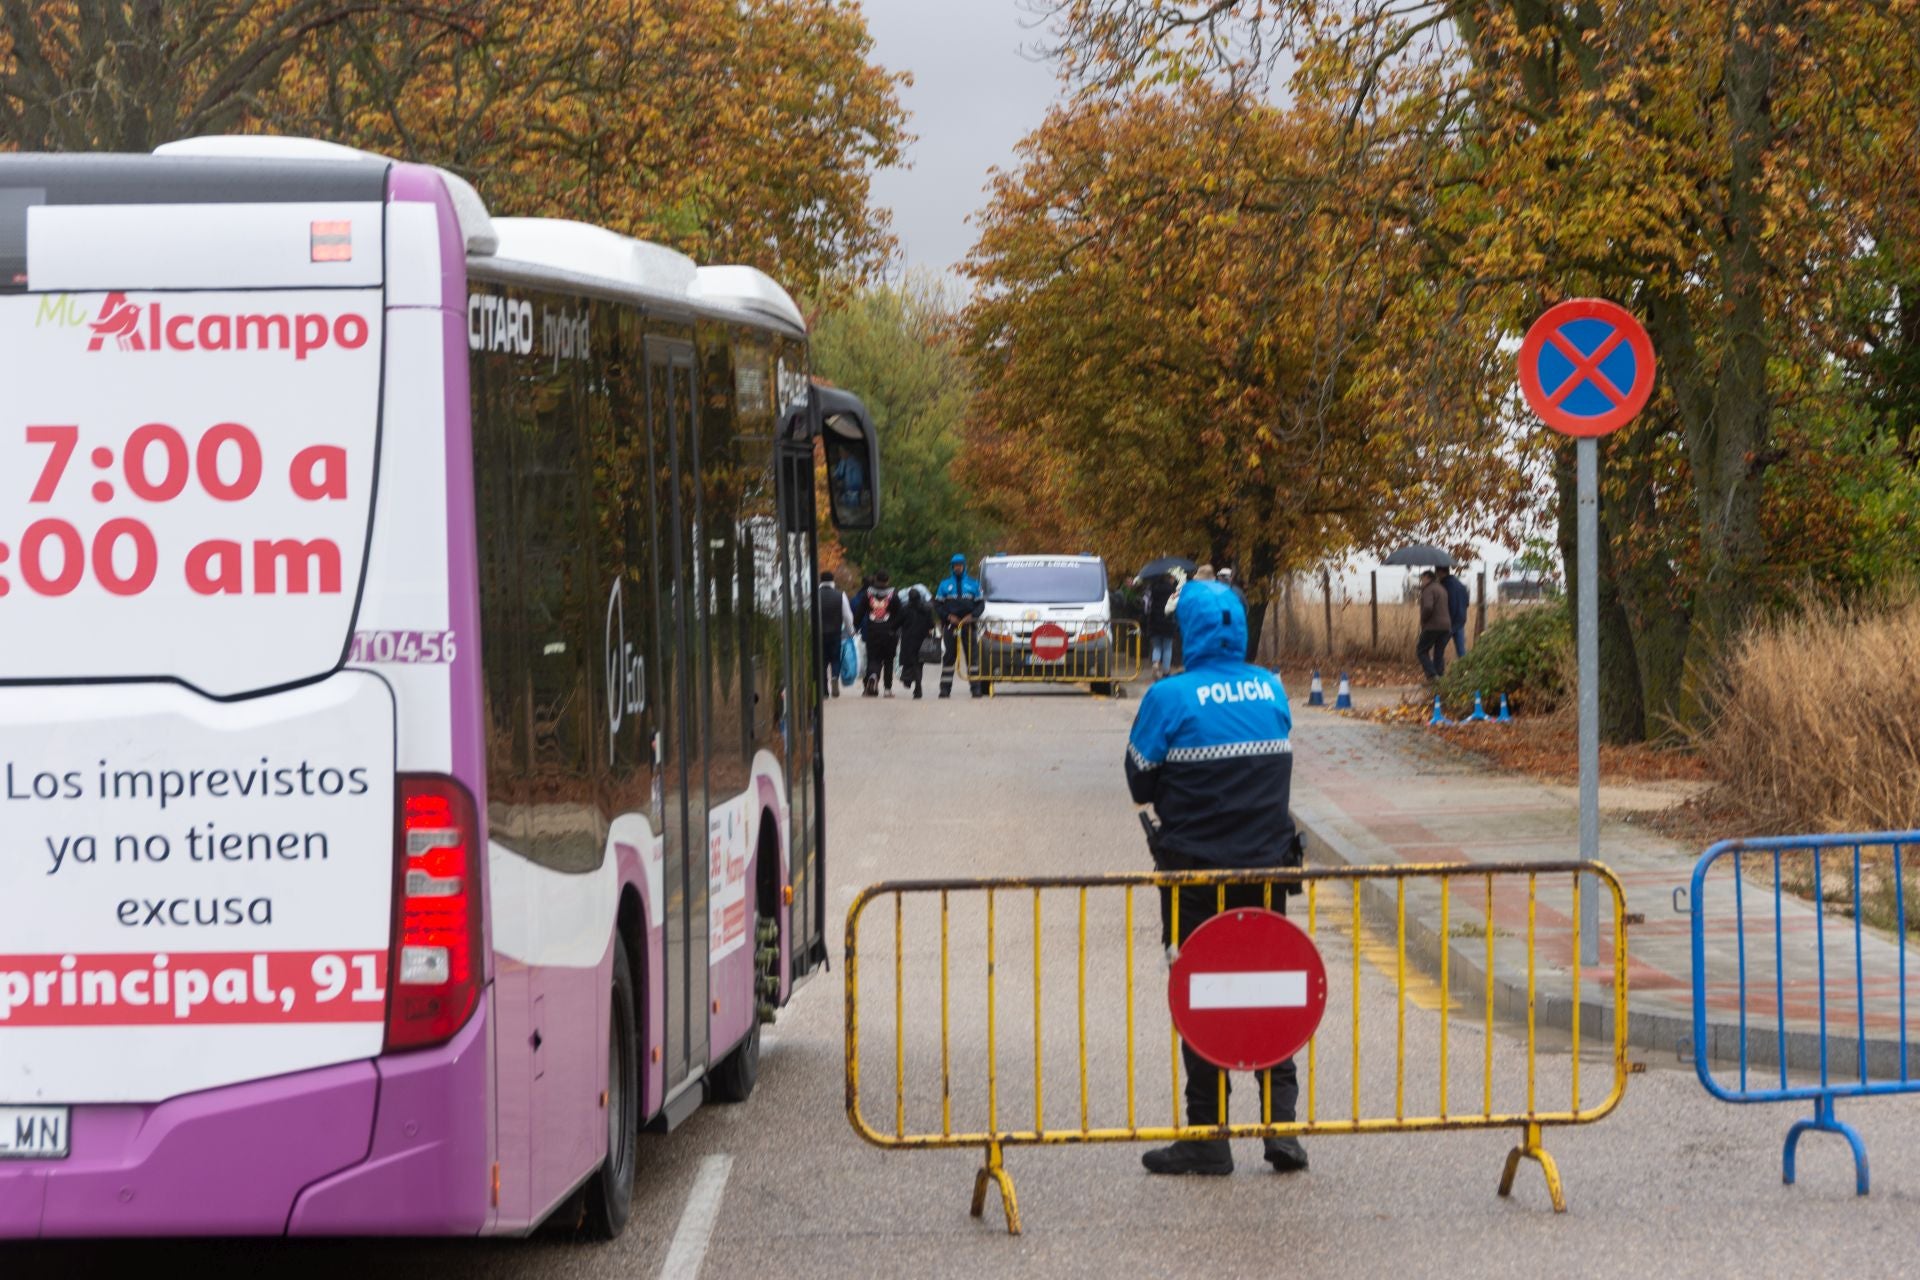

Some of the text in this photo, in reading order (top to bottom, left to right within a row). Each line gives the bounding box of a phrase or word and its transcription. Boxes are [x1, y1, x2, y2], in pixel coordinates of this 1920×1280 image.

[87, 291, 369, 360] Alcampo
[468, 293, 589, 375] CITARO hybrid
[25, 422, 347, 503] 7:00 a
[184, 537, 342, 595] am
[624, 642, 646, 714] Eco
[1196, 677, 1275, 706] POLICÍA
[6, 757, 369, 809] Los imprevistos
[45, 822, 329, 874] ya no tienen
[116, 896, 273, 926] excusa
[0, 953, 386, 1019] principal, 91
[0, 1116, 59, 1148] MN
